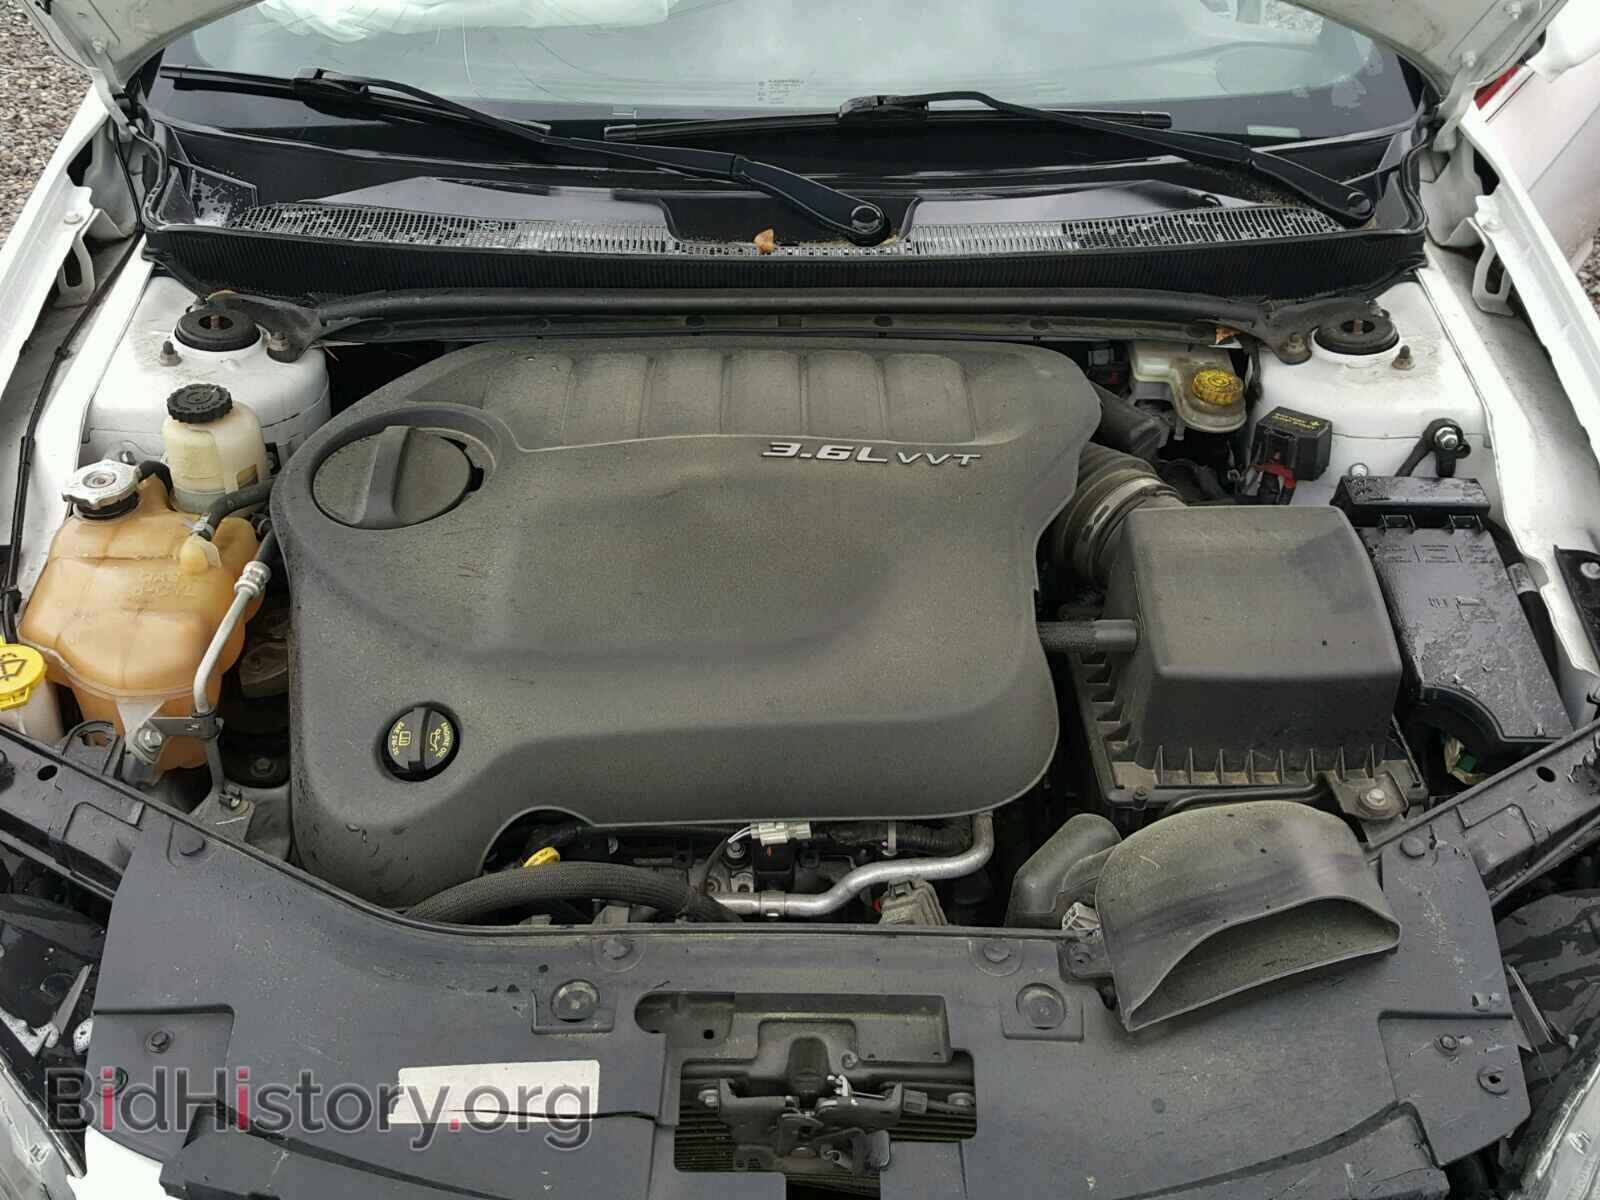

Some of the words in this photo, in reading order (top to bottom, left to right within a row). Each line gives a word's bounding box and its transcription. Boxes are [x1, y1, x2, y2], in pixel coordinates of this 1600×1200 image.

[761, 441, 889, 464] 3.6L
[897, 451, 982, 467] VVT
[440, 721, 451, 747] ENGINE
[435, 747, 448, 758] OIL
